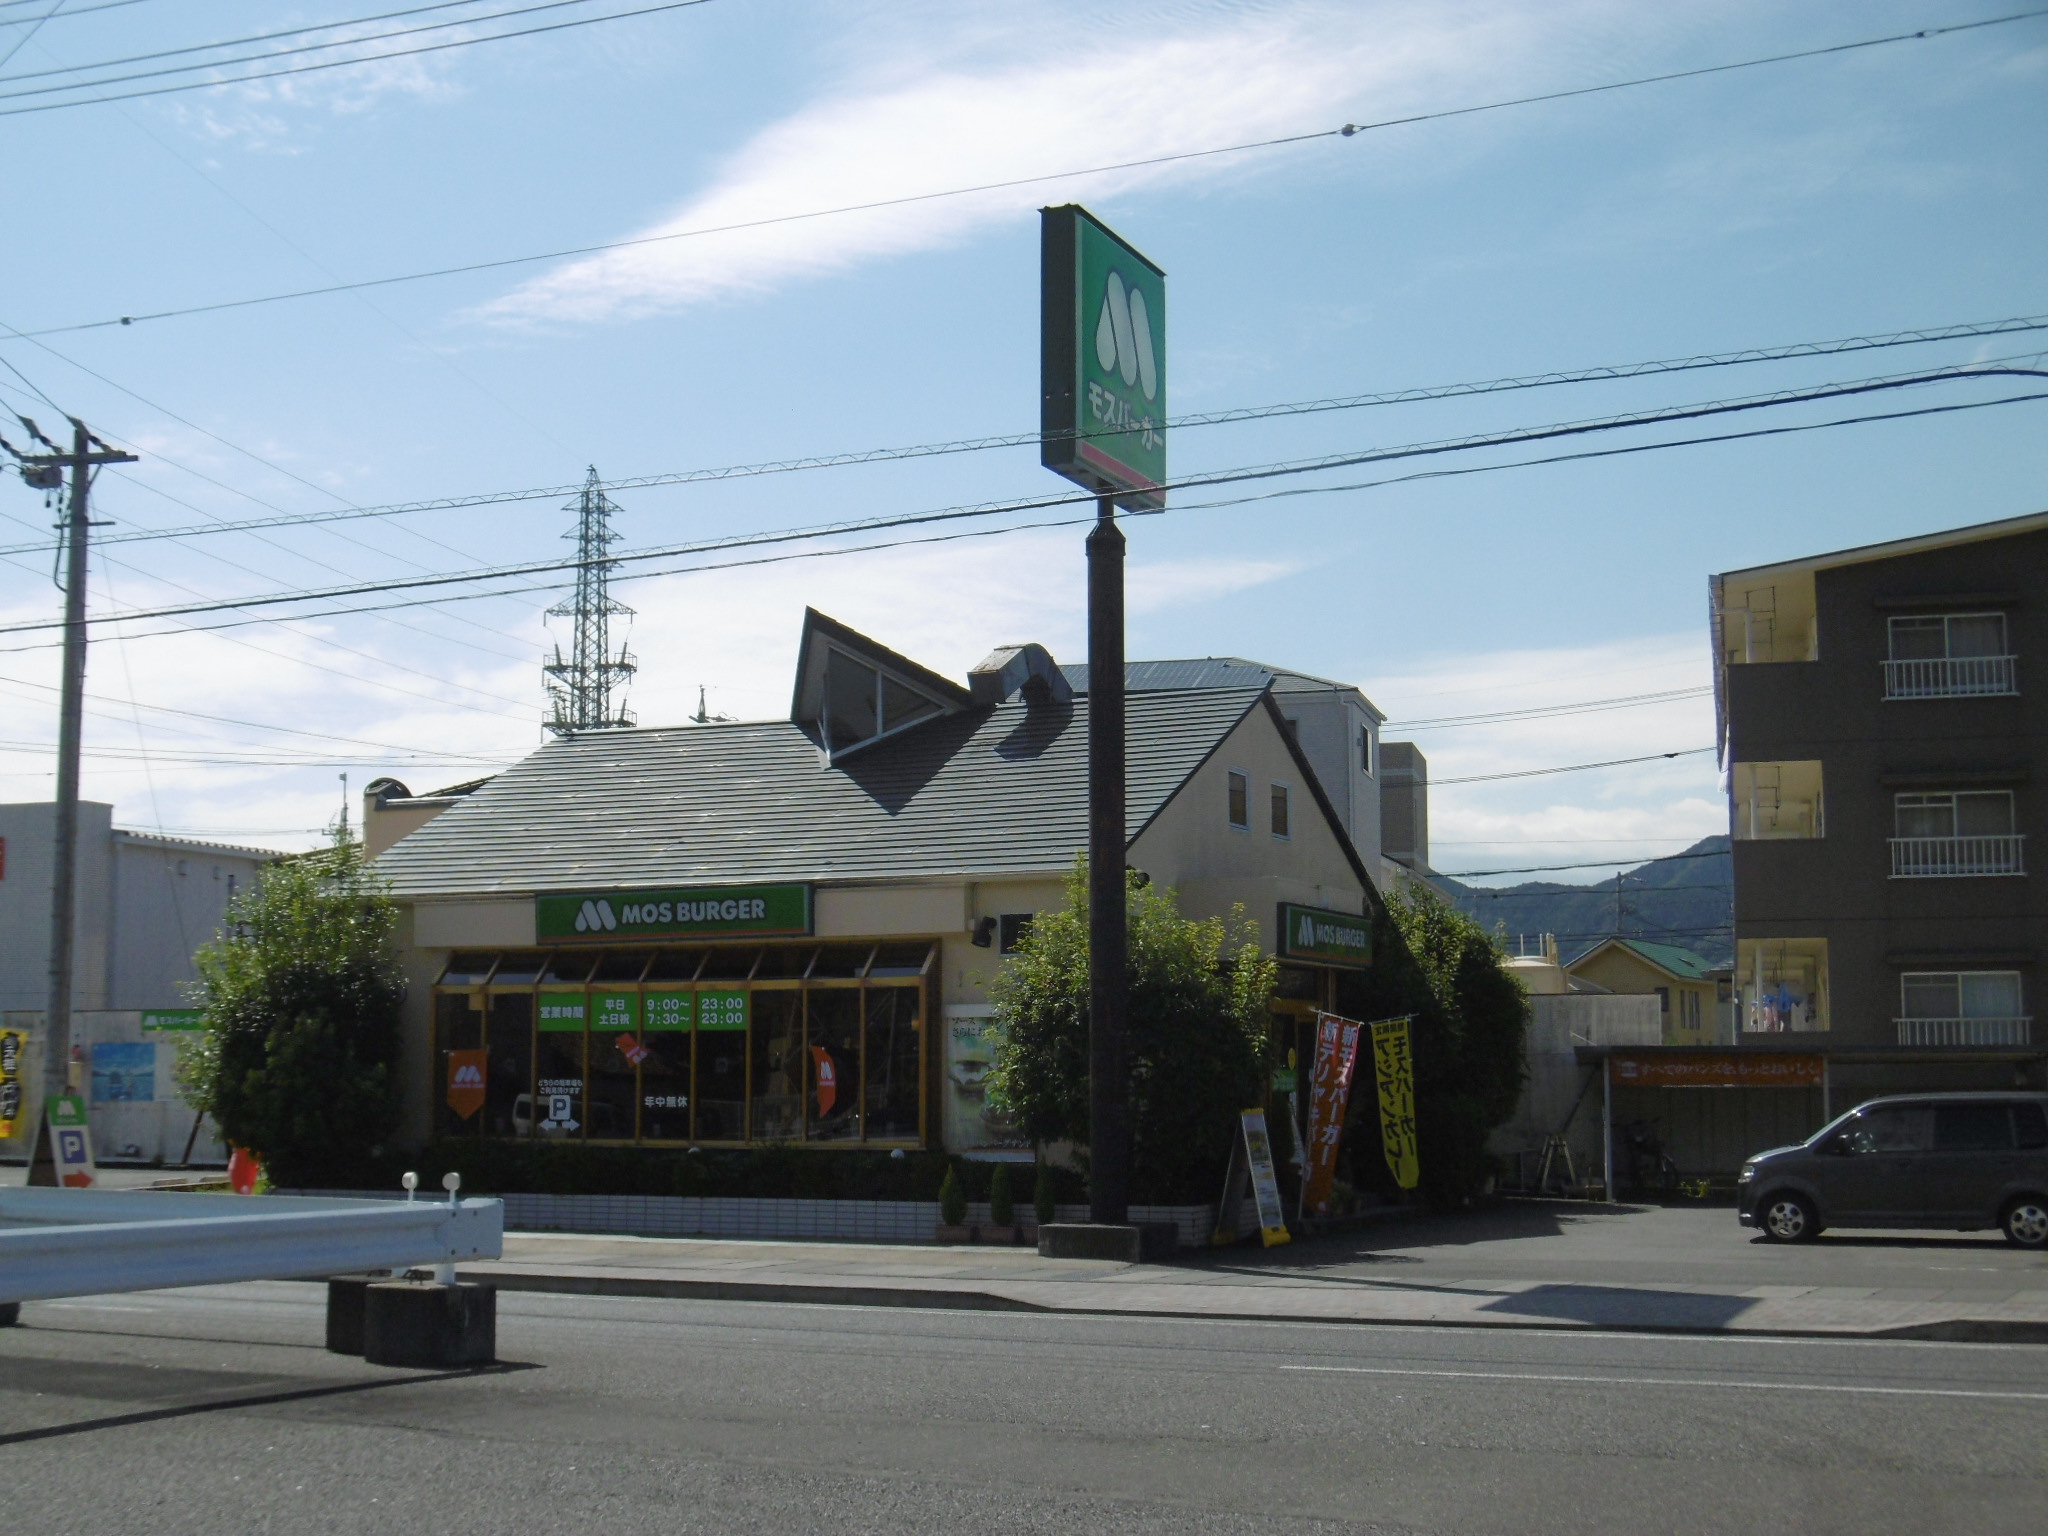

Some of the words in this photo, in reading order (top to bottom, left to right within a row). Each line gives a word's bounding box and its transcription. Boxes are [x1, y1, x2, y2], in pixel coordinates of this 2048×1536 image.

[1088, 381, 1163, 451] モスバーガー
[621, 902, 673, 925] MOS
[677, 898, 765, 923] BURGER
[1316, 923, 1335, 944] MOS
[1335, 926, 1366, 949] BURGER
[540, 1006, 584, 1019] 営業時間
[604, 999, 625, 1010] 平日
[701, 998, 743, 1010] 23:00
[598, 1013, 630, 1025] 土日祝
[701, 1012, 743, 1024] 23:00
[644, 1096, 689, 1108] 年中無休
[1321, 1024, 1358, 1166] 新モスバーガー
[63, 1136, 81, 1159] P
